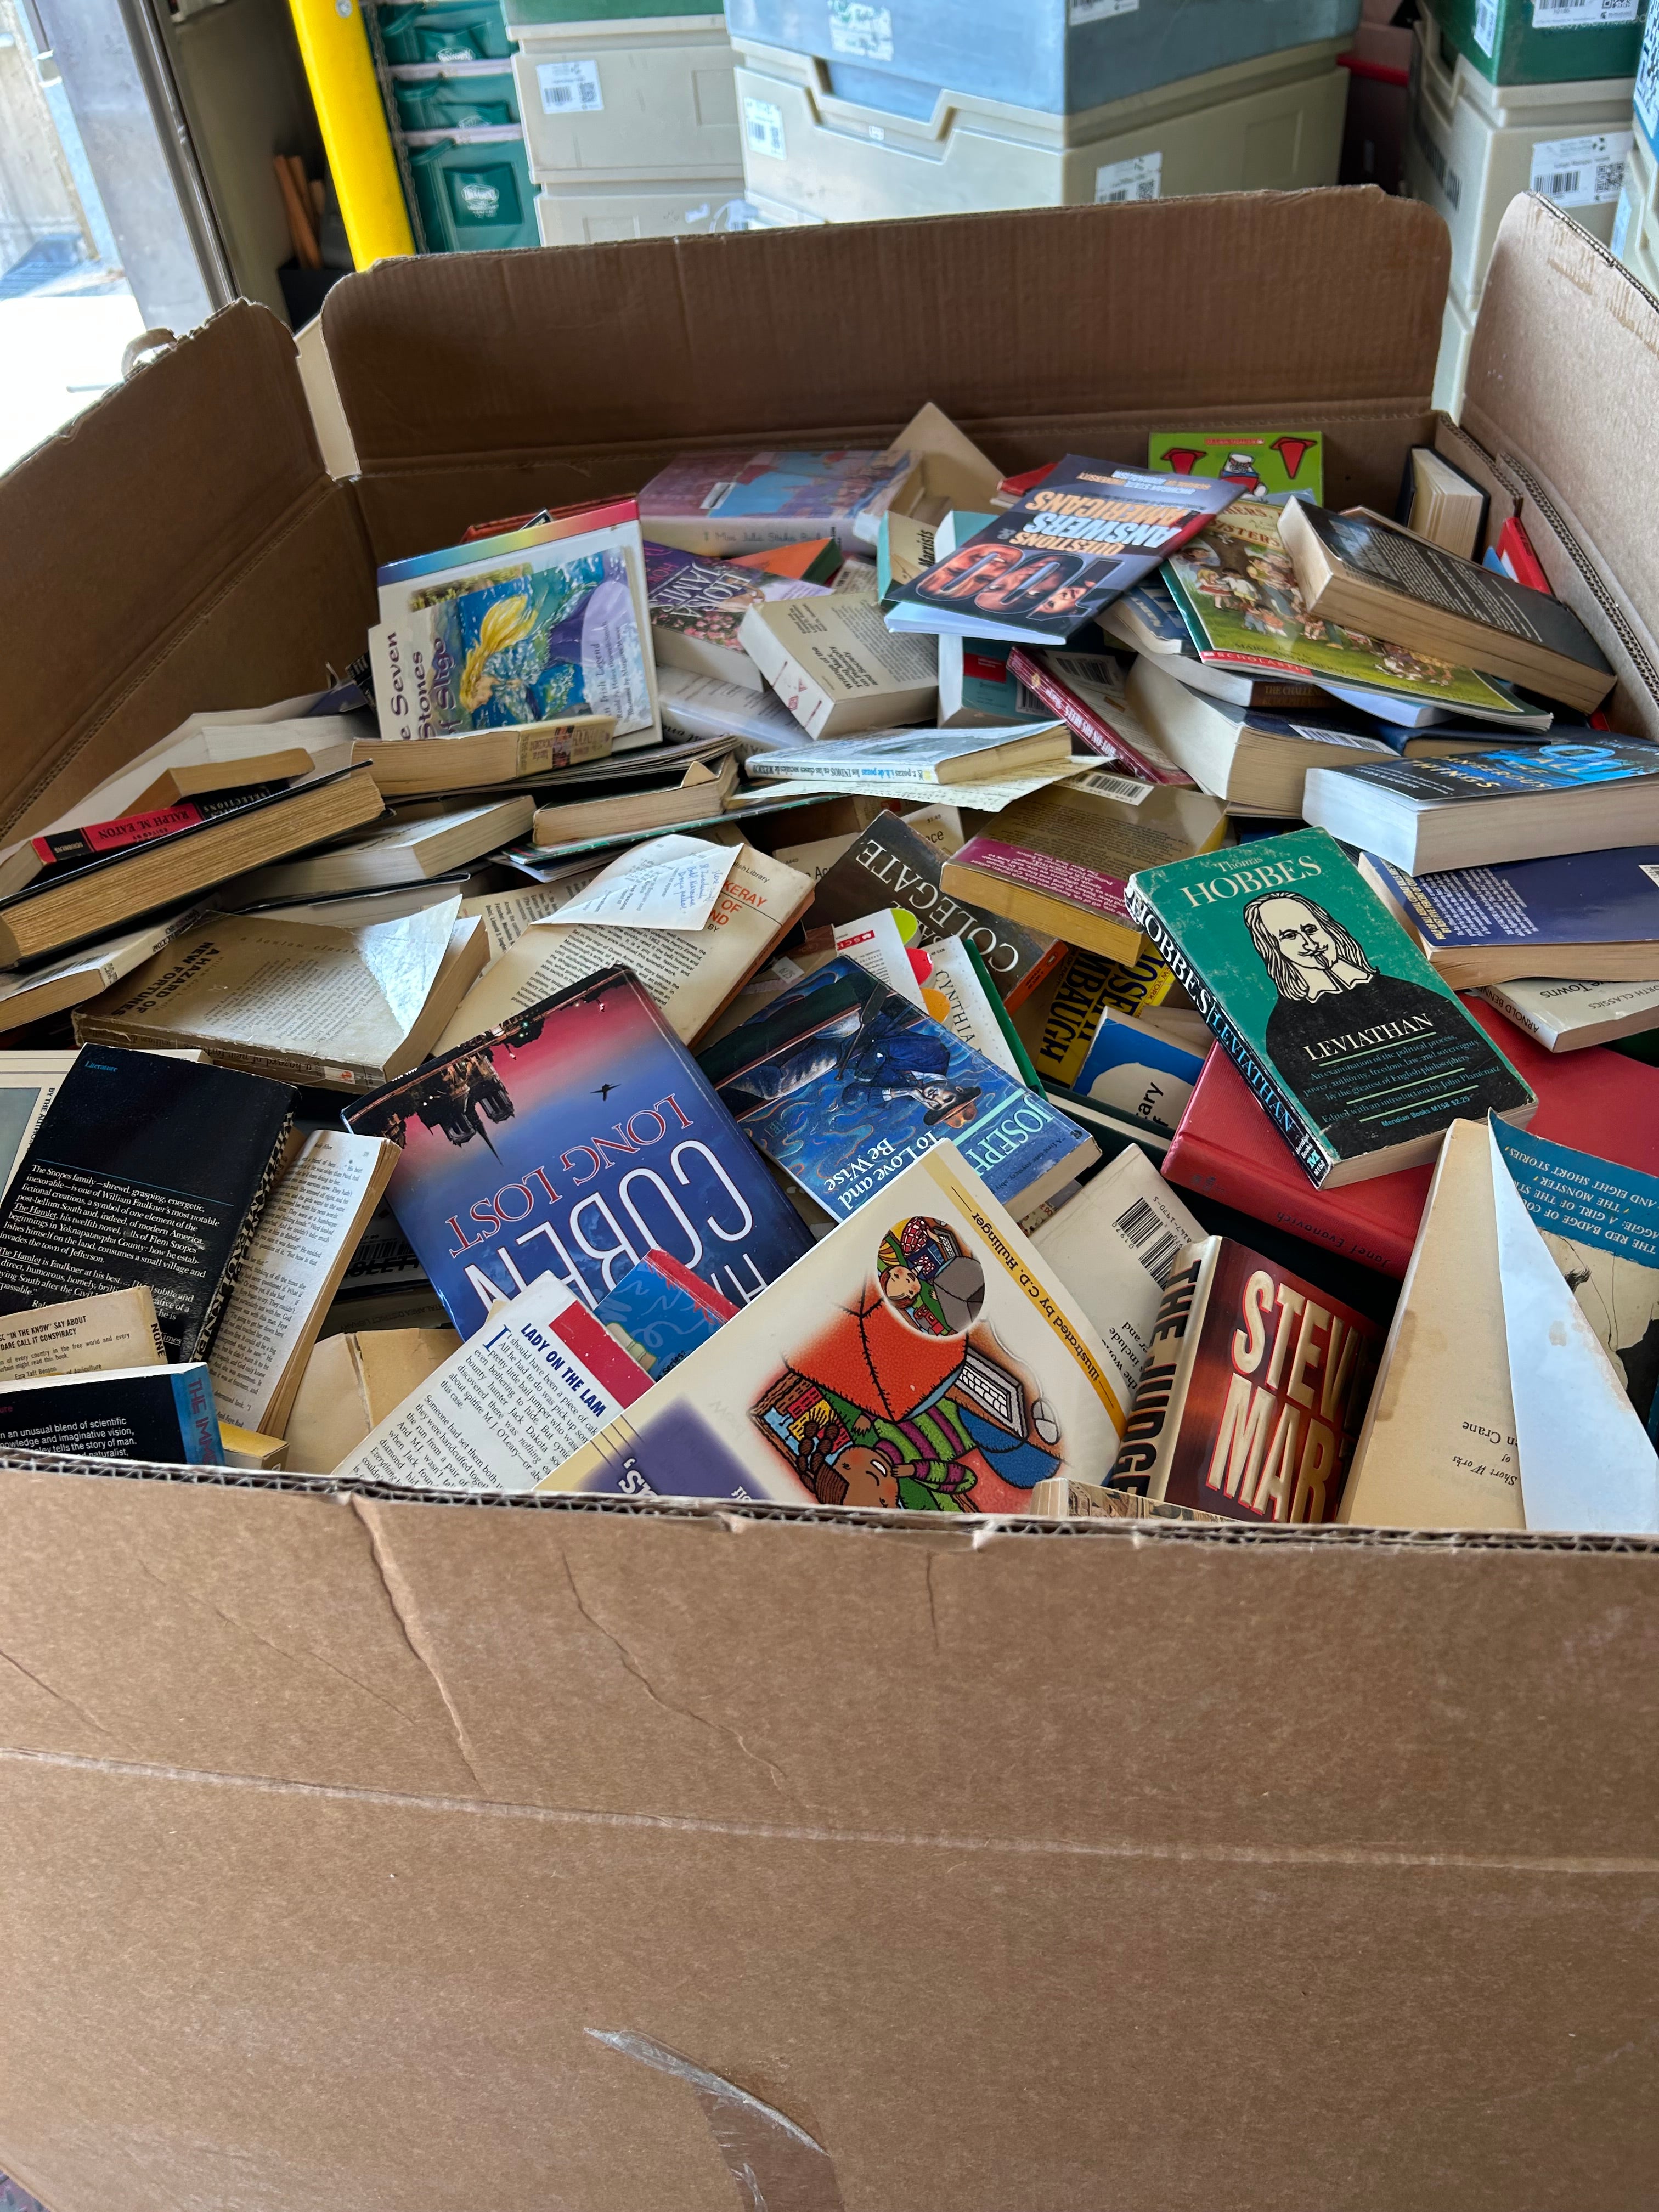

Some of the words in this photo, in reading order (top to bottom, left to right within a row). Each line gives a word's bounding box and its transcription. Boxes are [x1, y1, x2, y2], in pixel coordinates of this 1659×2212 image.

[1025, 490, 1190, 527] AMERICANS
[1023, 511, 1182, 549] ANSWERS
[1008, 531, 1125, 556] QUESTIONS
[670, 569, 753, 619] ELOISA
[915, 542, 1126, 621] 100
[386, 631, 411, 718] Seven
[433, 637, 457, 712] Sligo
[412, 651, 438, 738] Stones
[137, 819, 152, 829] M.
[153, 808, 189, 826] RALPH
[98, 823, 136, 839] EATON
[745, 865, 770, 883] Library
[1218, 853, 1264, 873] Thomas
[1180, 855, 1323, 908] HOBBES
[721, 880, 769, 910] KERAY
[721, 900, 742, 915] OF
[855, 837, 1019, 974] COLEGATE
[707, 924, 719, 933] BY
[711, 910, 730, 927] ND
[182, 942, 213, 964] NEW
[204, 947, 220, 955] A
[155, 958, 211, 997] HAZARD
[113, 967, 184, 1015] FORTUNES
[1587, 990, 1637, 1011] CLASSICS
[136, 1001, 156, 1013] OF
[936, 969, 974, 1042] CYNTHIA
[1129, 889, 1211, 1015] HOBBES
[1210, 1012, 1294, 1132] LEVIATHAN
[1504, 1004, 1541, 1033] ARNOLD
[1303, 1013, 1434, 1061] LEVIATHAN
[84, 1060, 119, 1074] Literature
[1324, 1059, 1373, 1076] examination
[1373, 1054, 1381, 1063] of
[1396, 1041, 1427, 1058] political
[1427, 1035, 1458, 1049] process,
[47, 1087, 55, 1097] BY
[41, 1098, 51, 1113] THE
[1381, 1115, 1410, 1126] Meridian
[1410, 1109, 1431, 1118] Books
[1431, 1102, 1451, 1111] M158
[1451, 1096, 1471, 1106] $2.25
[562, 1093, 695, 1185] LONG
[870, 1138, 896, 1161] Be
[909, 1129, 938, 1156] To
[876, 1147, 915, 1181] Love
[1510, 1148, 1550, 1171] STORIES
[823, 1155, 871, 1193] Wise
[1551, 1167, 1590, 1185] SHORT
[32, 1164, 46, 1173] The
[46, 1168, 72, 1180] Snopes
[131, 1190, 166, 1204] grasping,
[168, 1199, 205, 1212] energetic,
[837, 1177, 878, 1211] and
[1534, 1189, 1556, 1205] THE
[1537, 1177, 1594, 1202] MONSTER
[1592, 1181, 1628, 1199] EIGHT
[1630, 1194, 1657, 1207] AND
[445, 1165, 564, 1259] LOST
[1544, 1209, 1559, 1220] OF
[1559, 1200, 1575, 1210] OF
[1579, 1205, 1605, 1221] GIRL
[1596, 1197, 1620, 1212] THE
[463, 1139, 754, 1312] COBEN
[1275, 1211, 1347, 1255] Evanovich
[1562, 1215, 1601, 1235] BADGE
[1605, 1231, 1629, 1244] RED
[970, 1210, 1020, 1273] Hullinger
[1632, 1239, 1656, 1254] THE
[1348, 1243, 1392, 1270] Janet
[1018, 1269, 1041, 1297] C.D.
[1036, 1296, 1051, 1317] by
[1153, 1259, 1203, 1347] THE
[18, 1328, 30, 1337] THE
[31, 1324, 52, 1334] KNOW"
[53, 1321, 65, 1329] SAY
[67, 1316, 86, 1327] ABOUT
[0, 1341, 15, 1353] DARE
[16, 1338, 32, 1347] CALL
[40, 1328, 76, 1342] CONSPIRACY
[150, 1322, 166, 1357] NONE
[1051, 1313, 1100, 1382] illustrated
[1232, 1269, 1366, 1427] STEV
[521, 1323, 550, 1352] LADY
[546, 1351, 565, 1370] ON
[562, 1367, 584, 1391] THE
[580, 1389, 606, 1417] LAM
[187, 1378, 208, 1415] THE
[20, 1425, 53, 1436] unusual
[54, 1422, 78, 1435] blend
[79, 1420, 88, 1429] of
[90, 1417, 127, 1431] scientific
[1462, 1420, 1502, 1445] Crane
[1451, 1455, 1486, 1475] Works
[1501, 1454, 1512, 1464] of
[1489, 1467, 1518, 1487] Short
